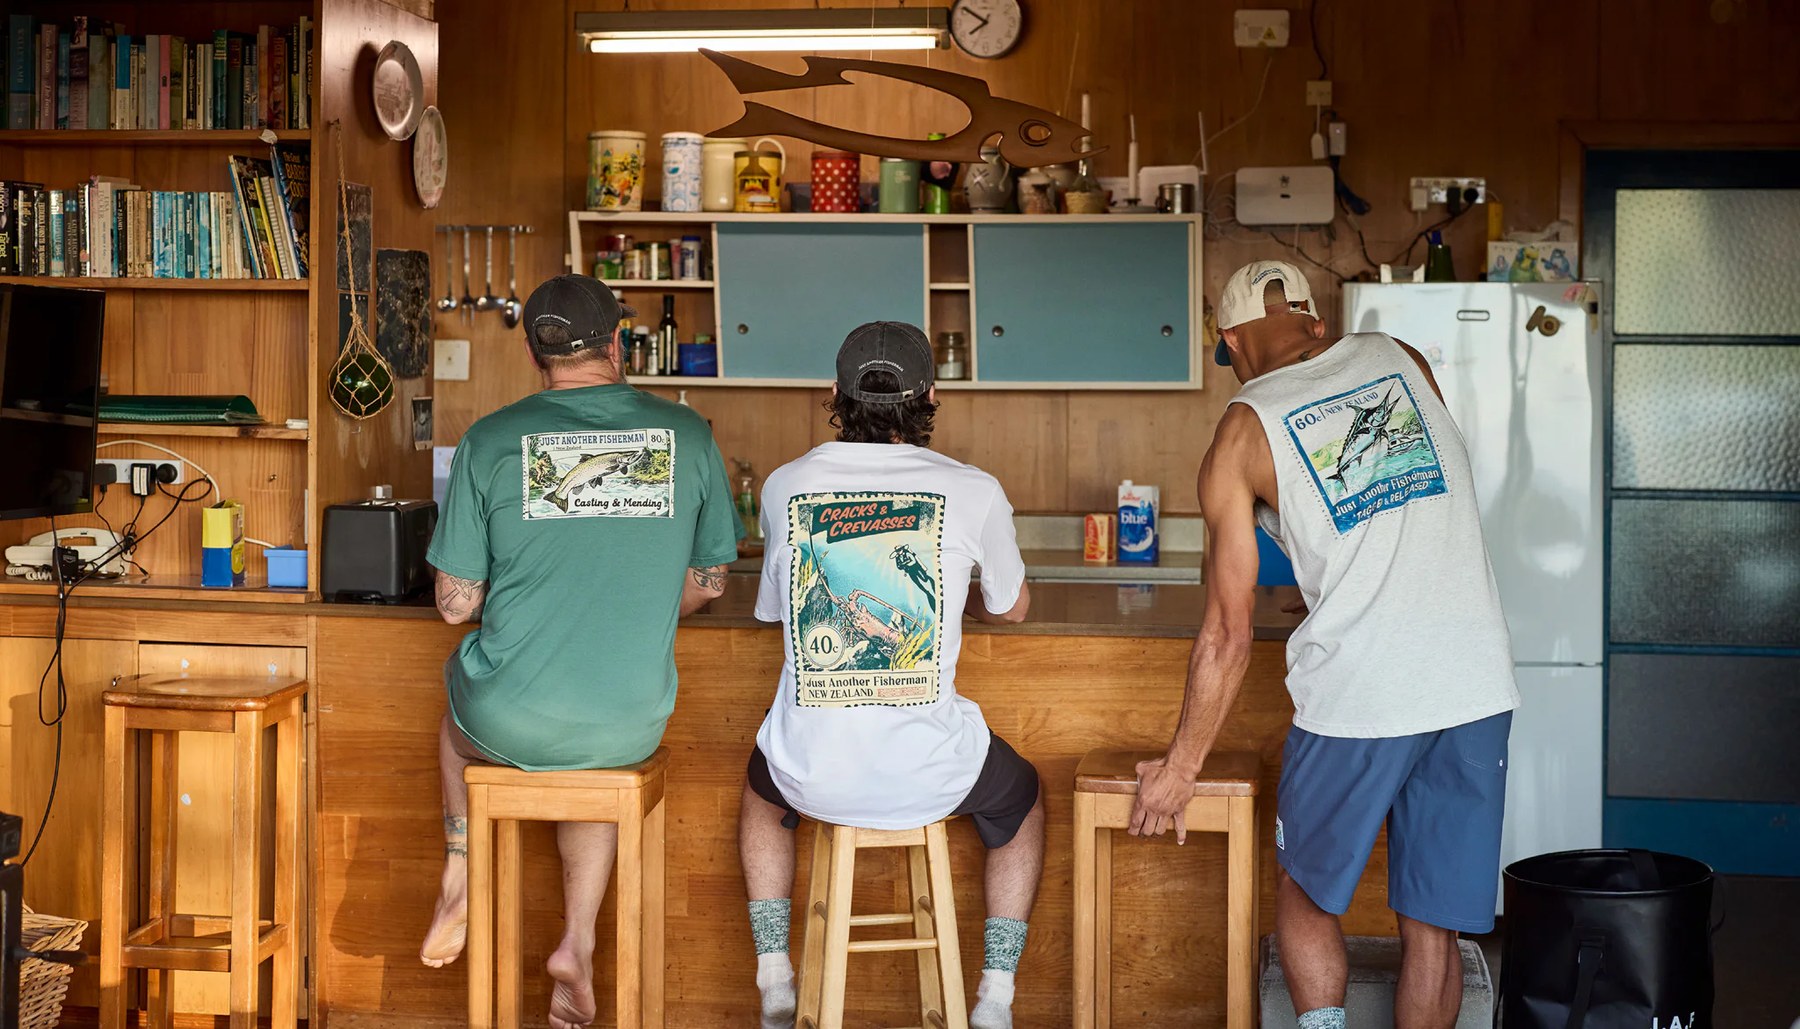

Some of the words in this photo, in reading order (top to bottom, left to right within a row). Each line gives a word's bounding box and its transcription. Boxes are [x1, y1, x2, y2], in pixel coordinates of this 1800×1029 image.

[1325, 405, 1343, 415] NEW
[1344, 392, 1379, 408] ZEALAND
[1295, 413, 1322, 430] 60c
[540, 436, 560, 446] JUST
[561, 435, 598, 445] ANOTHER
[599, 433, 645, 444] FISHERMAN
[574, 498, 609, 509] Casting
[612, 499, 621, 508] &
[623, 497, 662, 510] Mending
[1335, 500, 1357, 517] Just
[819, 502, 878, 524] CRACKS
[879, 505, 888, 516] &
[1121, 511, 1147, 524] blue
[829, 515, 917, 537] CREVASSES
[809, 635, 839, 655] 40c
[806, 677, 826, 688] Just
[828, 677, 870, 688] Another
[873, 675, 928, 687] Fisherman
[808, 689, 828, 699] NEW
[830, 688, 874, 699] ZEALAND
